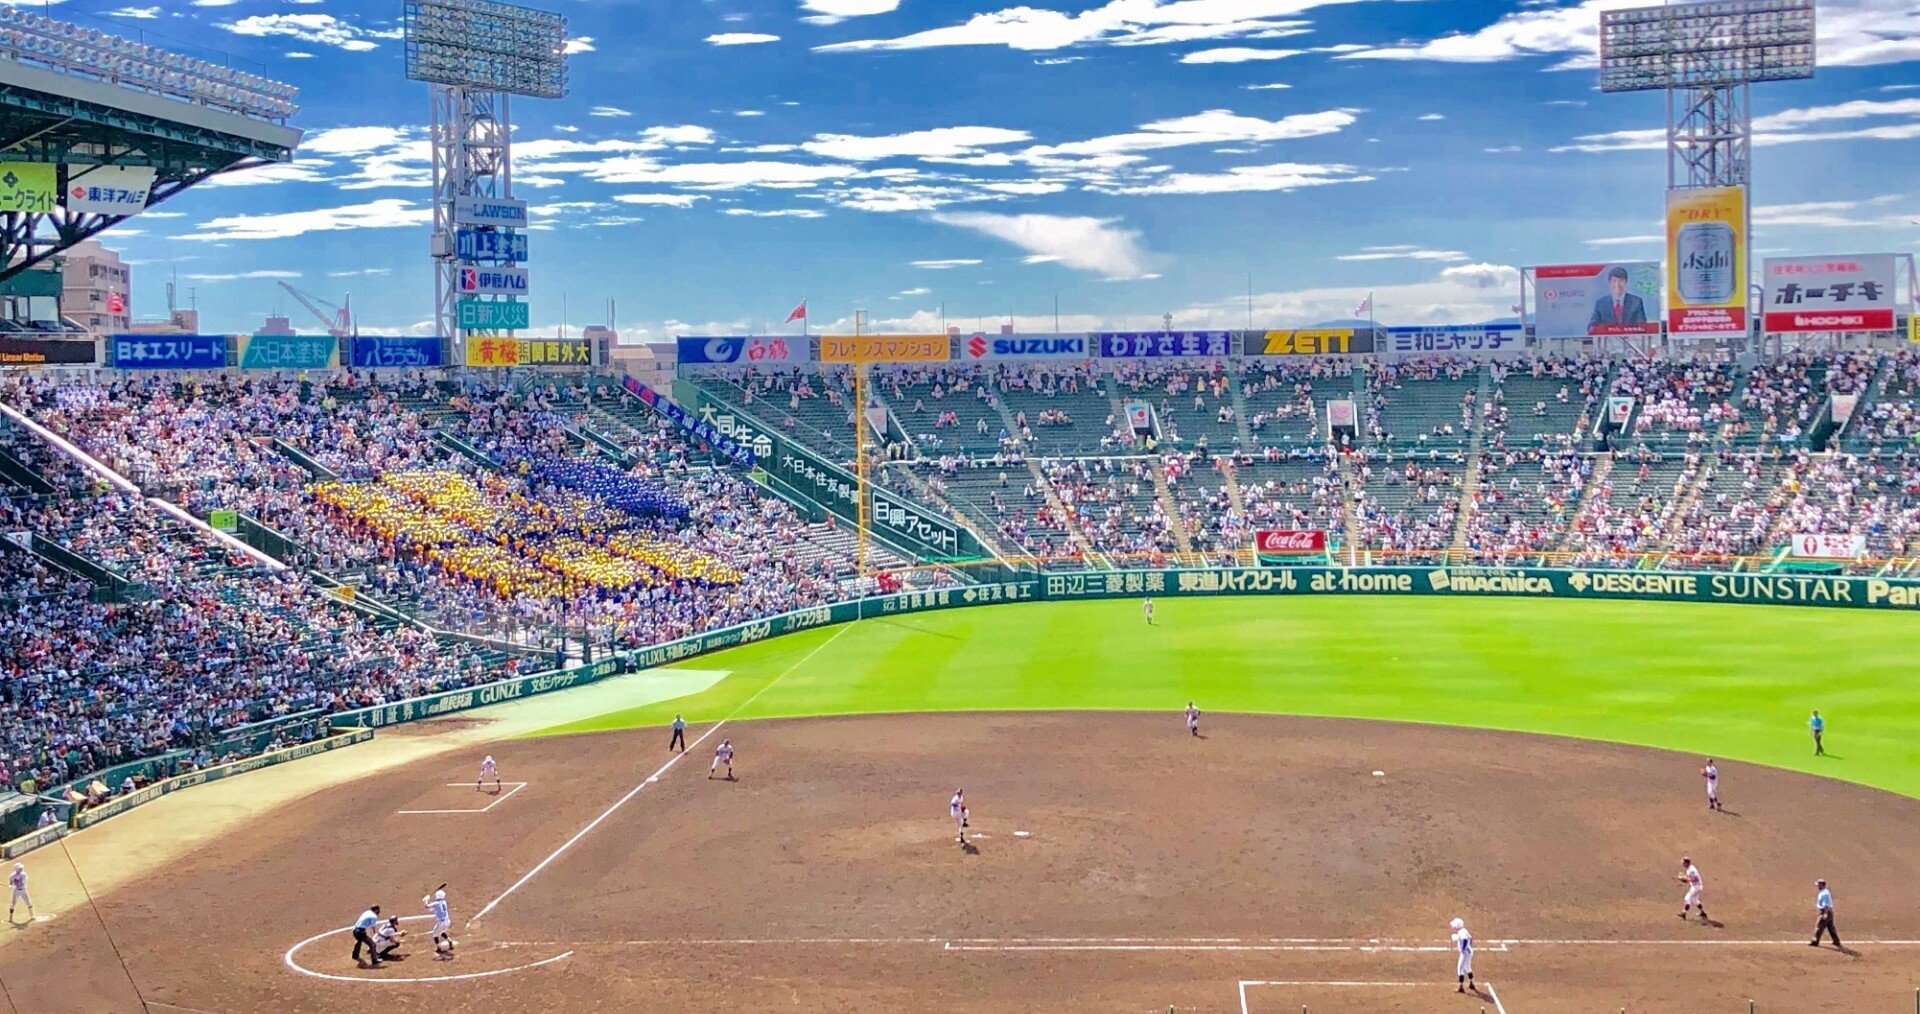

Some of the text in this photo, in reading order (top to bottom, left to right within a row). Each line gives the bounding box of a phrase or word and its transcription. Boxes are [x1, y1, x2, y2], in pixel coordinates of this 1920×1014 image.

[88, 186, 147, 205] 東洋アルミ
[473, 203, 526, 220] LAWSON
[460, 232, 528, 260] 川上塗料
[1682, 250, 1729, 270] Asahi
[478, 272, 527, 289] 伊藤ハム
[1774, 280, 1884, 304] ホーチキ
[1559, 289, 1585, 298] MUFG
[462, 303, 527, 325] 日新火災
[117, 341, 224, 361] 日本エスリード
[479, 339, 517, 364] 黄桜
[748, 338, 788, 361] 白鶴
[993, 338, 1083, 354] SUZUKI
[1110, 333, 1226, 356] わかさ生活
[1263, 329, 1355, 354] ZETT
[1395, 331, 1514, 351] 三和シャッター
[251, 342, 327, 365] 大日本塗料
[382, 346, 429, 365] ろうきん
[699, 402, 773, 459] 大同生命
[782, 453, 859, 505] 大日本住友製薬
[875, 501, 955, 550] 日興アセット
[1047, 572, 1165, 596] 田辺三菱製薬
[1178, 570, 1297, 592] 東進ハイスクール
[1310, 567, 1413, 591] at home
[1593, 573, 1698, 595] DESCENTE
[1711, 574, 1853, 602] SUNSTAR
[978, 583, 1032, 601] 住友電工
[645, 648, 667, 666] LIXIL
[480, 681, 523, 704] GUNZE
[355, 702, 414, 728] 大和証券
